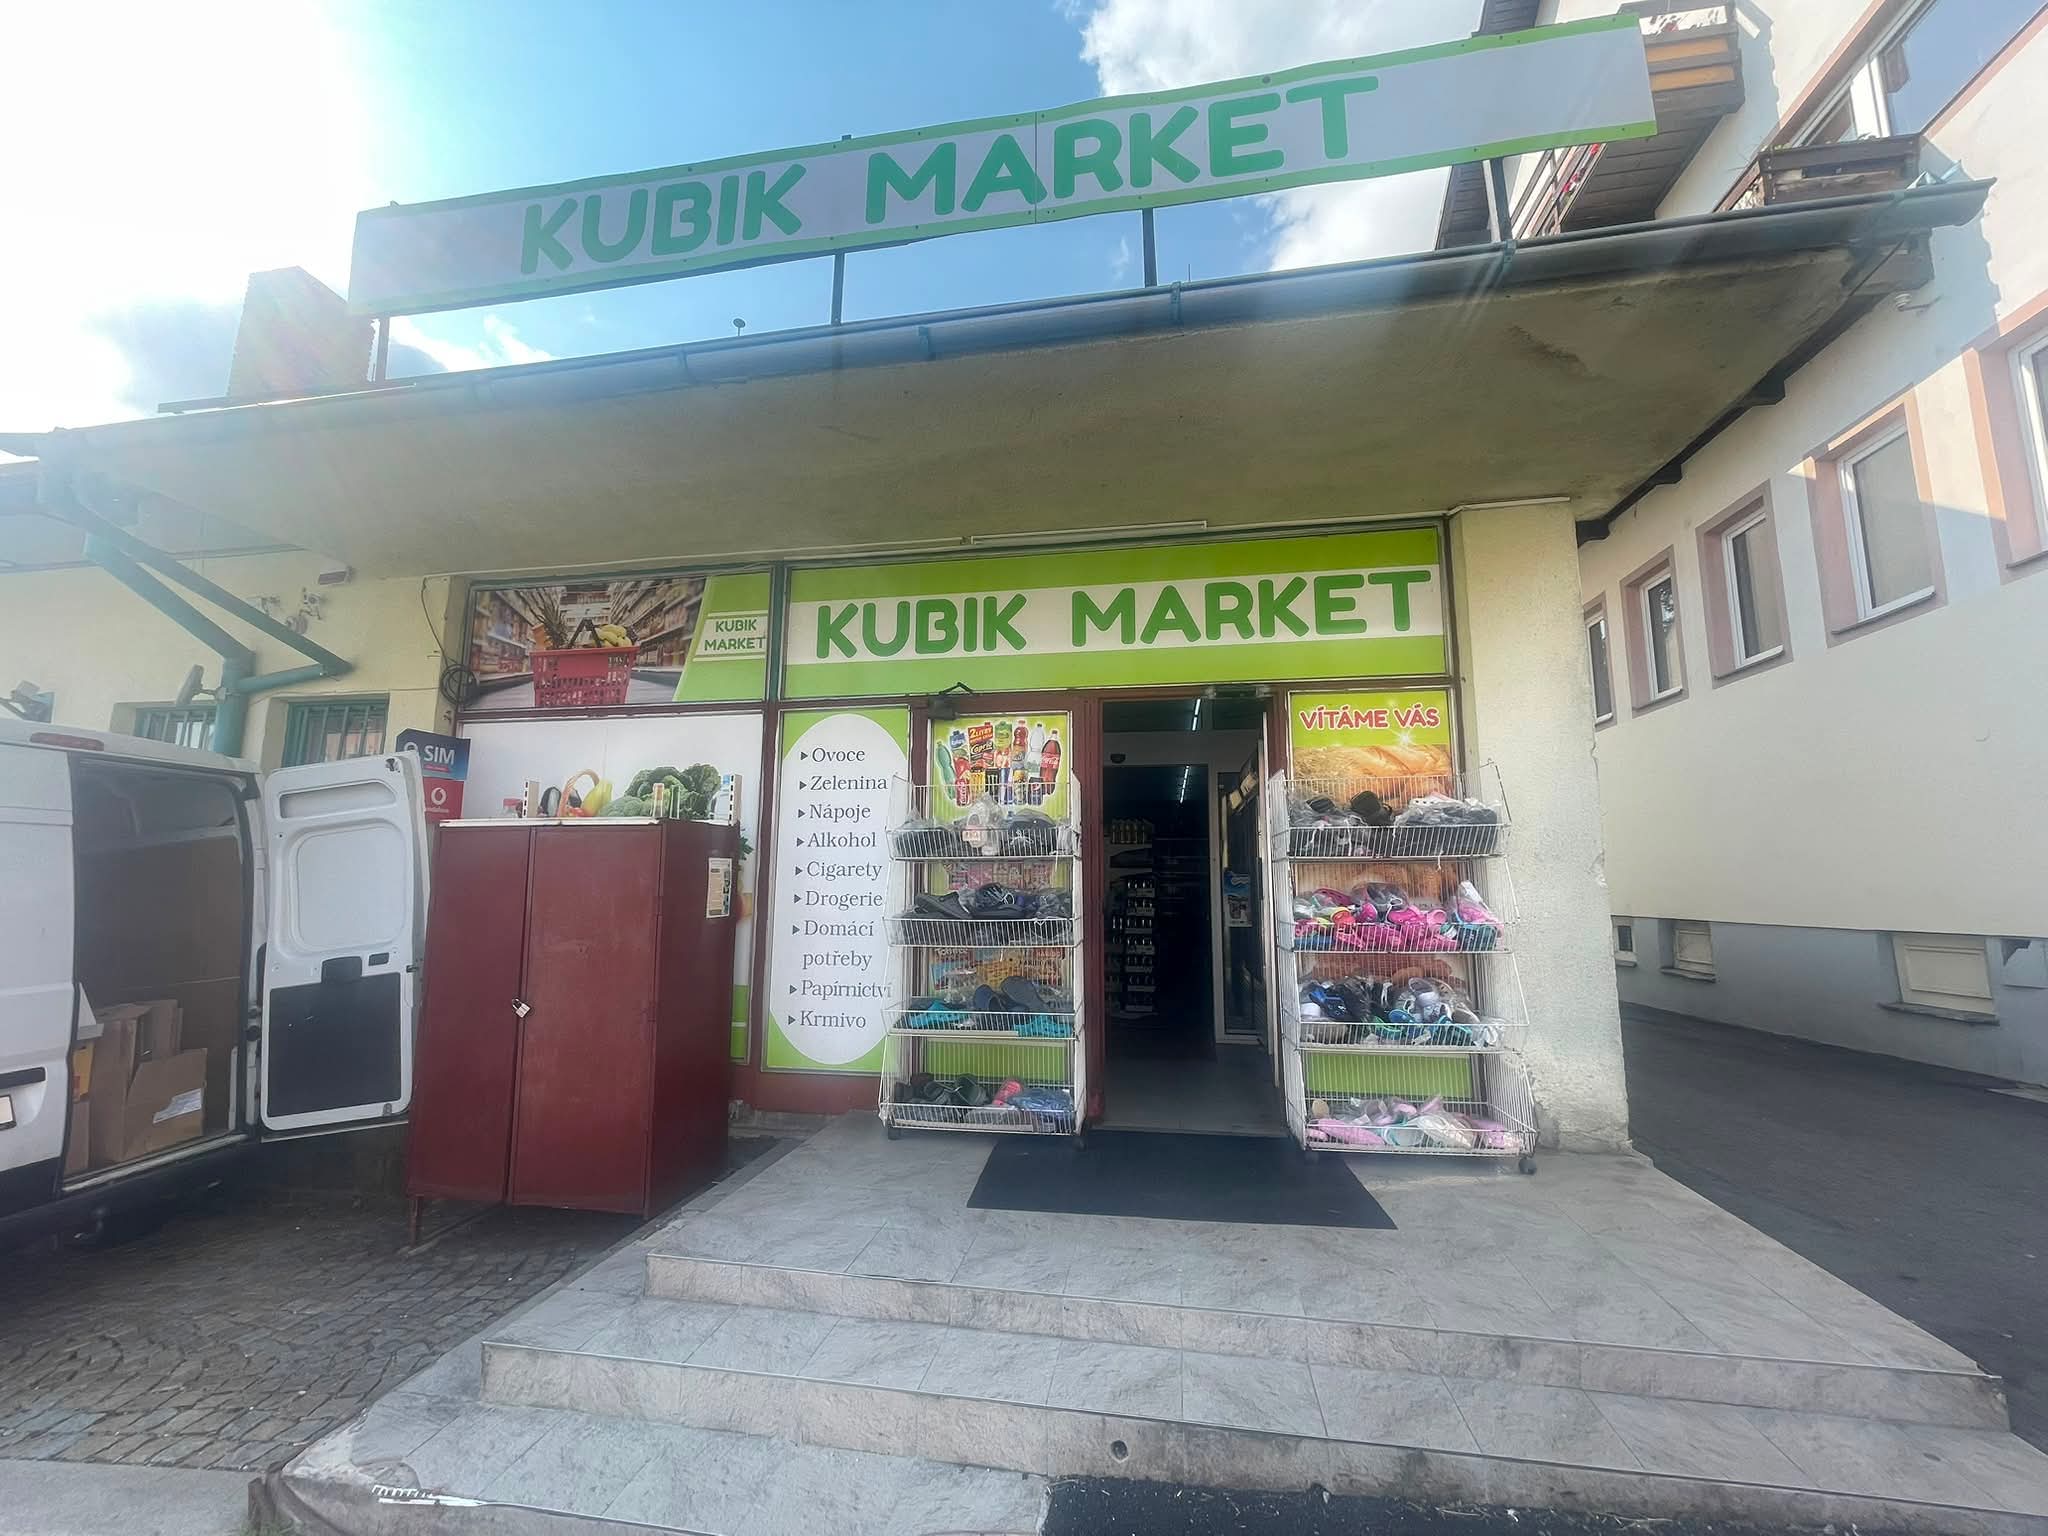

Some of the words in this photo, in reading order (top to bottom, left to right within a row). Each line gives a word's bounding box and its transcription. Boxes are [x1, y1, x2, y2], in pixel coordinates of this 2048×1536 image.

[521, 163, 807, 274] KUBIK
[865, 75, 1379, 224] MARKET
[816, 593, 1027, 659] KUBIK
[1071, 569, 1432, 647] MARKET
[716, 619, 757, 632] KUBIK
[704, 635, 766, 651] MARKET
[1300, 706, 1389, 730] VÍTÁME
[1394, 704, 1439, 728] VÁS
[424, 744, 455, 765] SIM
[811, 747, 866, 764] Ovoce
[810, 776, 888, 791] Zelenina
[809, 804, 871, 823] Nápoje
[807, 832, 877, 848] Alkohol
[806, 861, 882, 881] Cigarety
[805, 891, 883, 909] Drogerie
[804, 920, 874, 937] Domácí
[802, 950, 873, 970] potřeby
[800, 1010, 866, 1028] Krmivo
